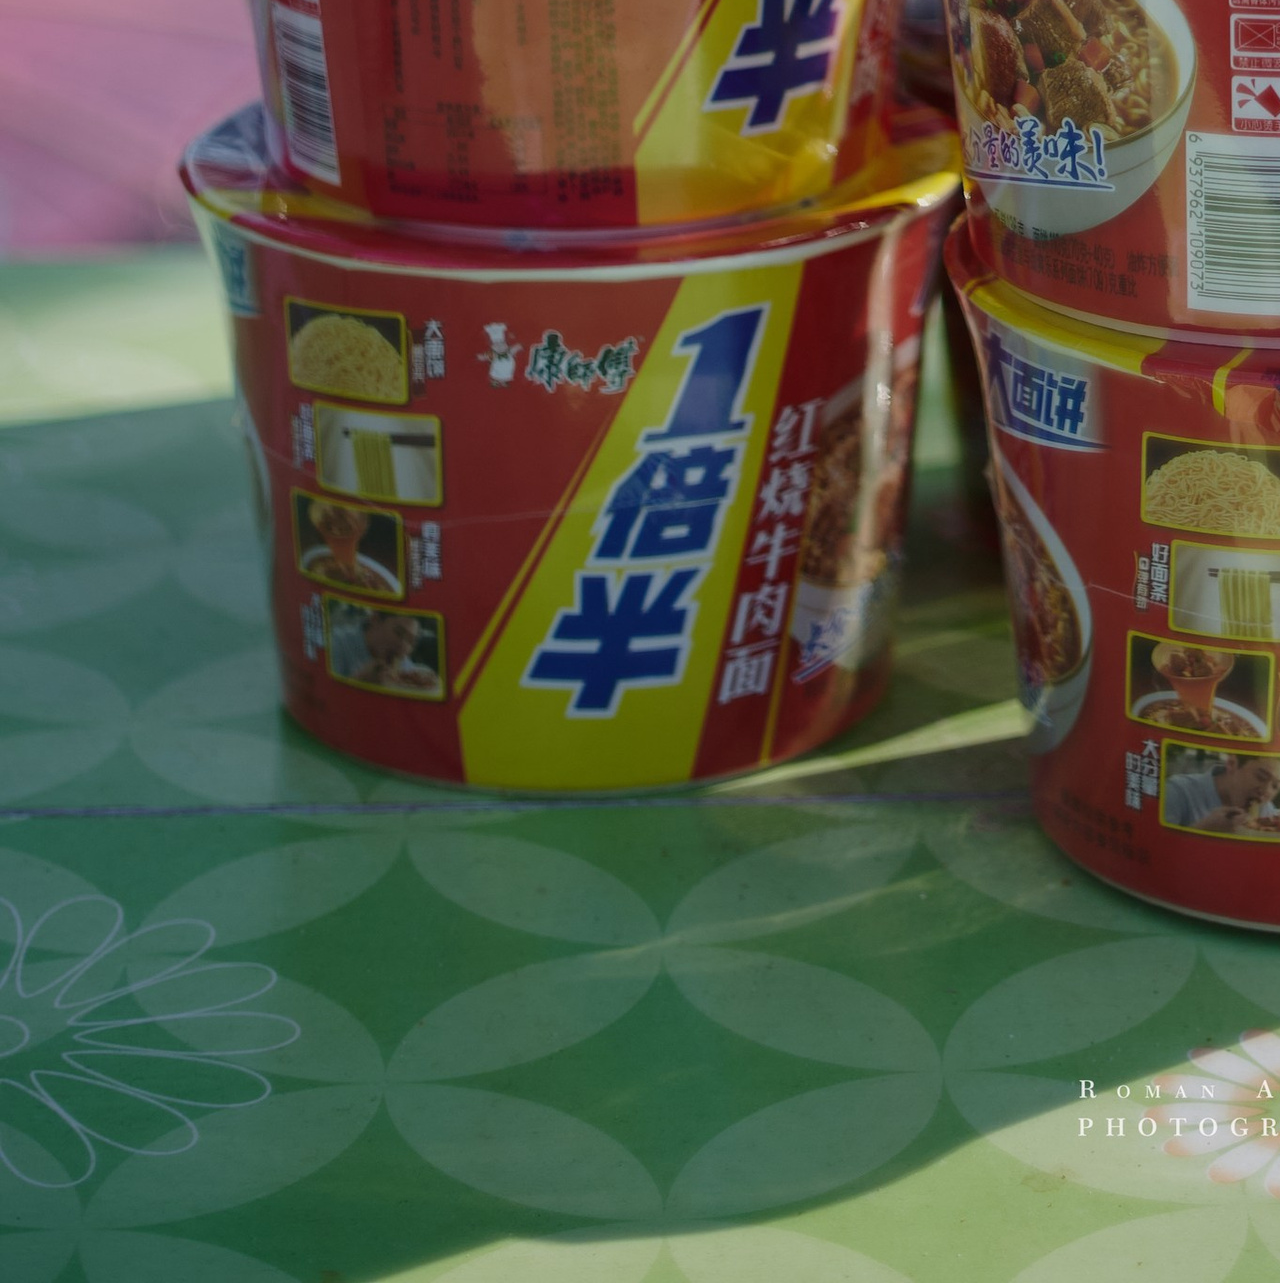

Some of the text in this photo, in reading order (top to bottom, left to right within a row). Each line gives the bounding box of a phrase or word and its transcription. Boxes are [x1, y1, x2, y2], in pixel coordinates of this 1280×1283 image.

[1188, 133, 1205, 291] 6 937962 109073
[526, 329, 638, 393] 康師傅
[525, 307, 766, 713] 1倍半
[719, 398, 824, 704] 红烧牛肉面
[1150, 542, 1170, 603] 好面条
